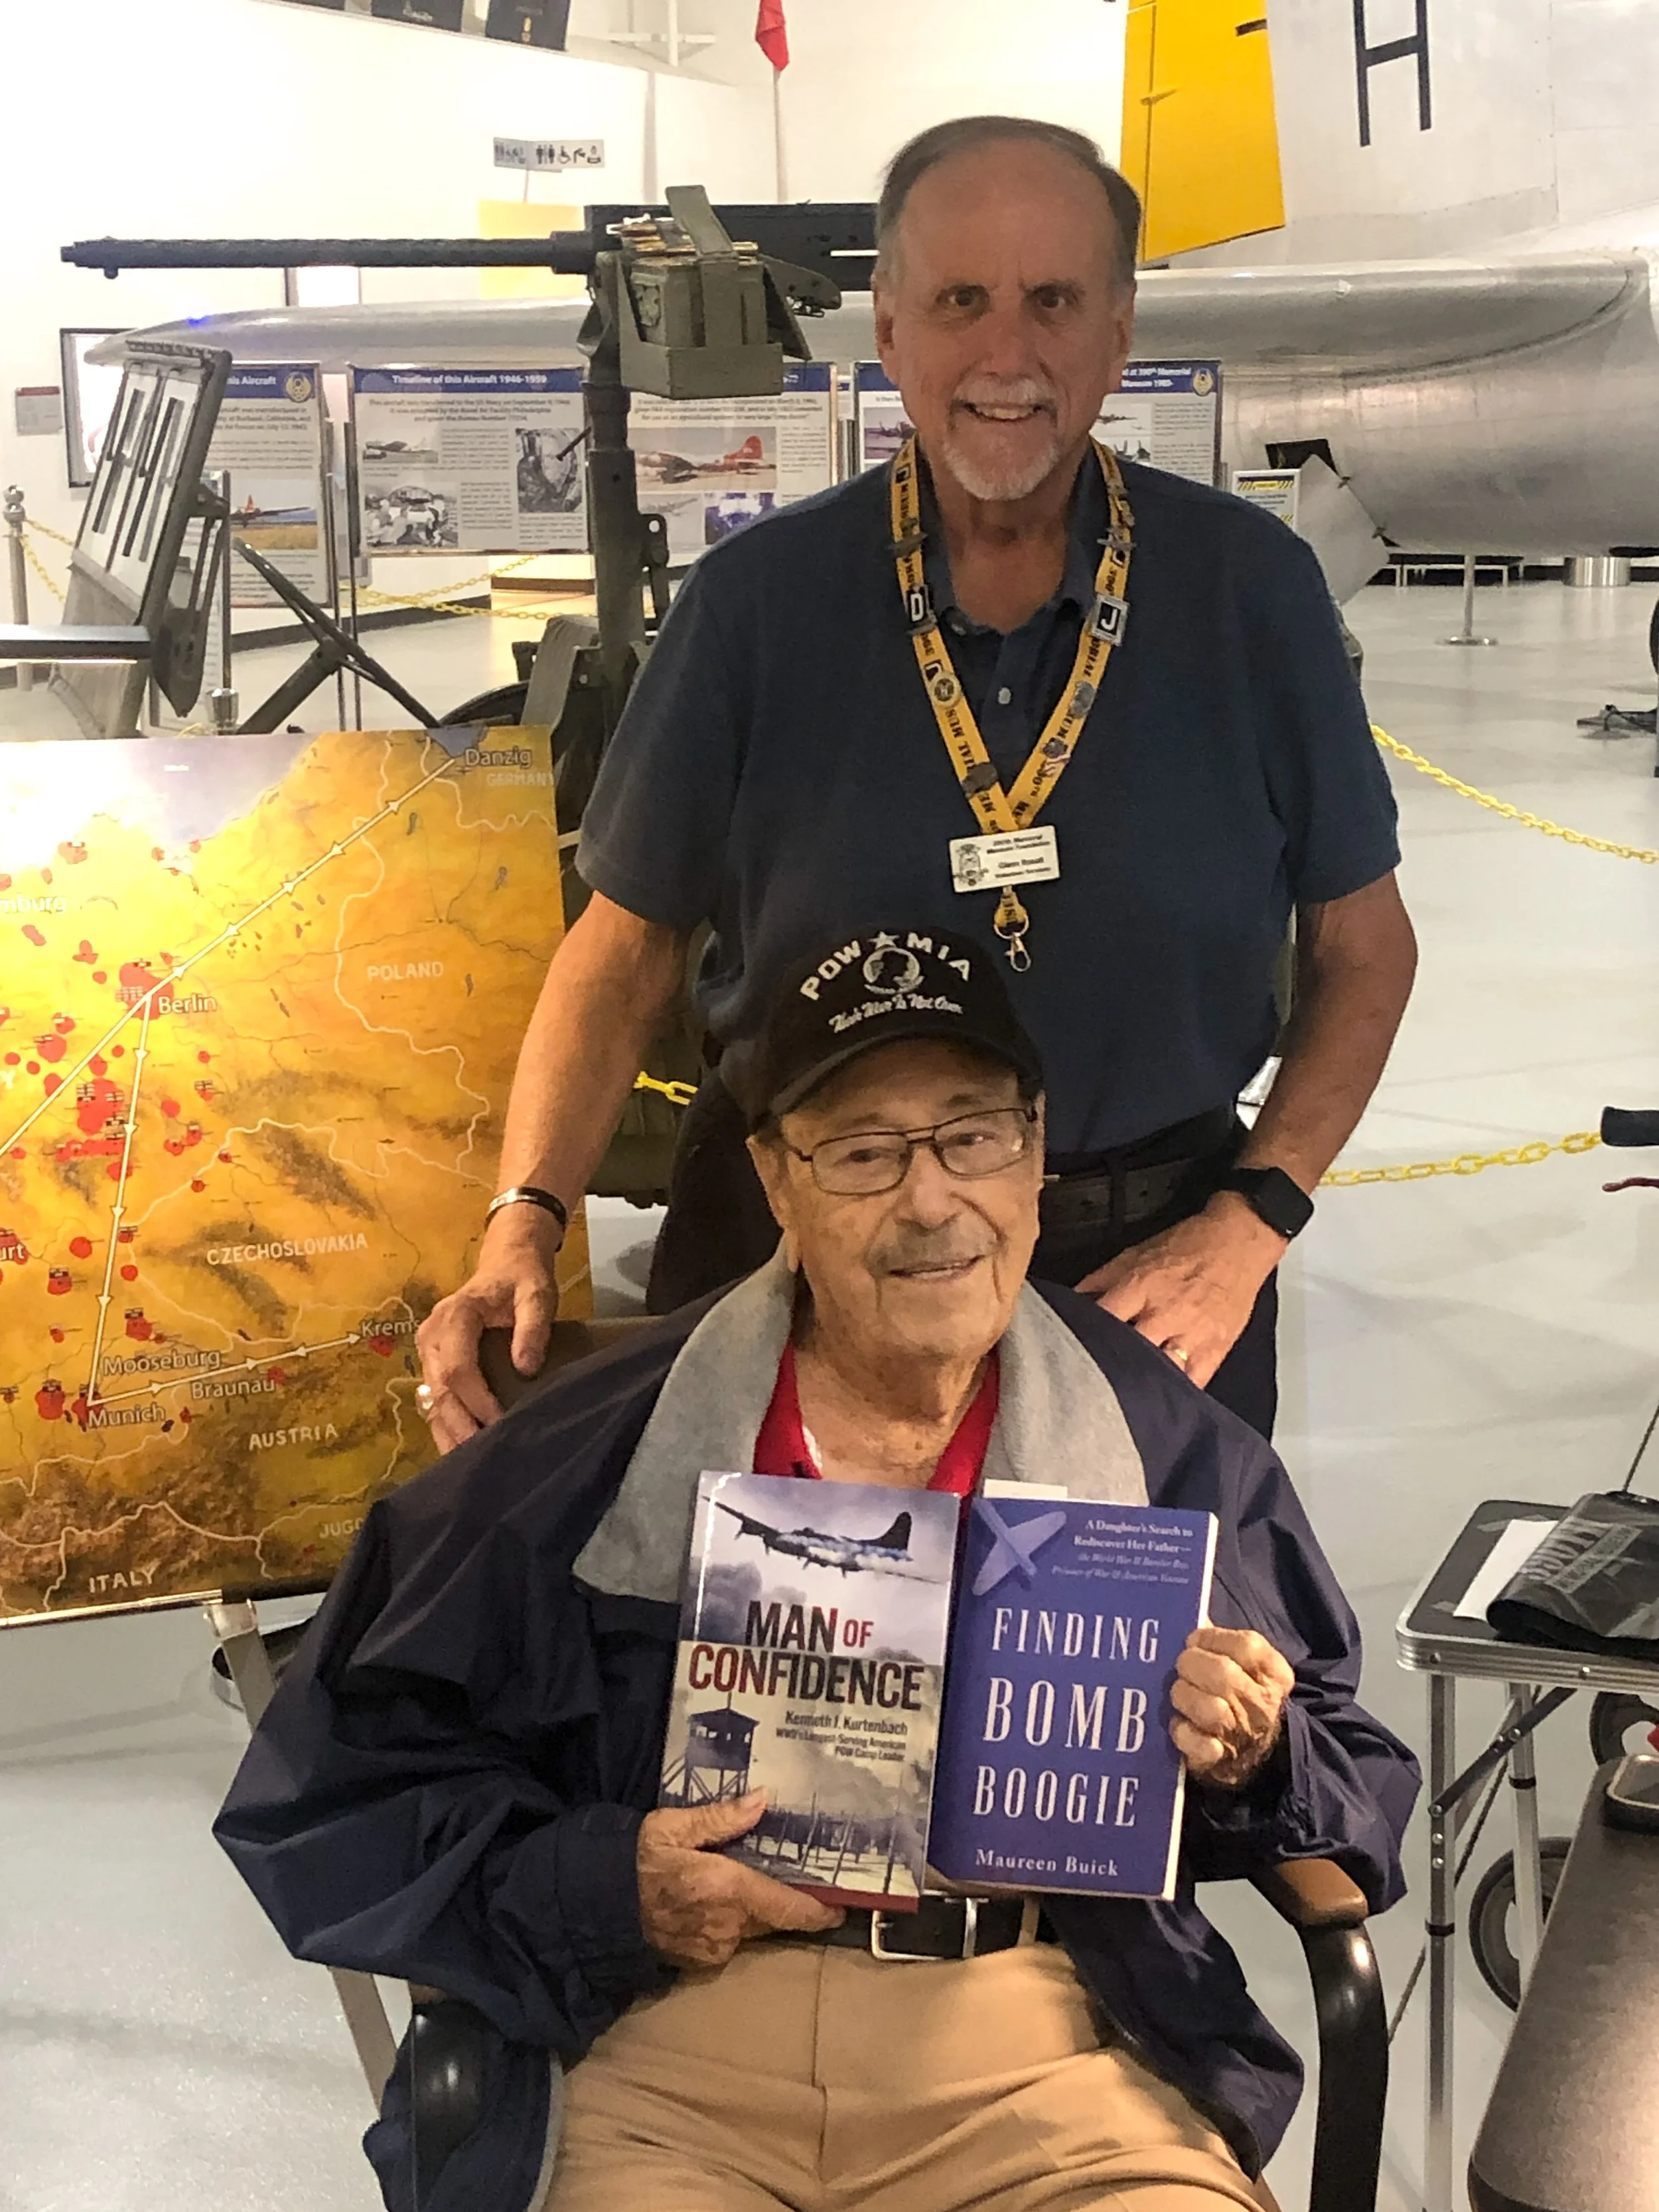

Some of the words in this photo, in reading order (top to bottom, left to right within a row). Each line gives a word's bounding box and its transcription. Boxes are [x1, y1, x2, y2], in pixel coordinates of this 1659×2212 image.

[241, 376, 277, 385] Aircraft
[392, 374, 431, 384] Timeline
[432, 374, 443, 384] of
[444, 374, 462, 383] this
[463, 374, 497, 383] Aircraft
[1100, 608, 1119, 631] J
[465, 747, 532, 769] Danzig
[367, 961, 444, 981] POLAND
[800, 940, 862, 1001] POW
[906, 932, 970, 982] MIA
[158, 993, 217, 1014] Berlin
[206, 1232, 369, 1265] CZECHOSLOVAKIA
[103, 1349, 221, 1376] Mooseburg
[191, 1379, 276, 1400] Braunau
[88, 1403, 166, 1428] Munich
[248, 1423, 339, 1451] AUSTRIA
[1085, 1519, 1094, 1530] A
[1096, 1519, 1147, 1534] Daughter's
[1149, 1523, 1181, 1536] Search
[1182, 1528, 1194, 1537] to
[1074, 1535, 1125, 1549] Rediscover
[1127, 1539, 1147, 1551] Her
[90, 1565, 157, 1592] ITALY
[745, 1600, 839, 1653] MAN
[842, 1619, 875, 1648] OF
[991, 1607, 1160, 1664] FINDING
[689, 1643, 924, 1711] CONFIDENCE
[785, 1710, 831, 1728] Kenneth
[843, 1716, 908, 1736] Kurtenbach
[982, 1677, 1148, 1754] BOMB
[869, 1736, 906, 1750] American
[973, 1765, 1139, 1827] BOOGIE
[975, 1848, 1057, 1872] Maureen
[1064, 1855, 1119, 1877] Buick
